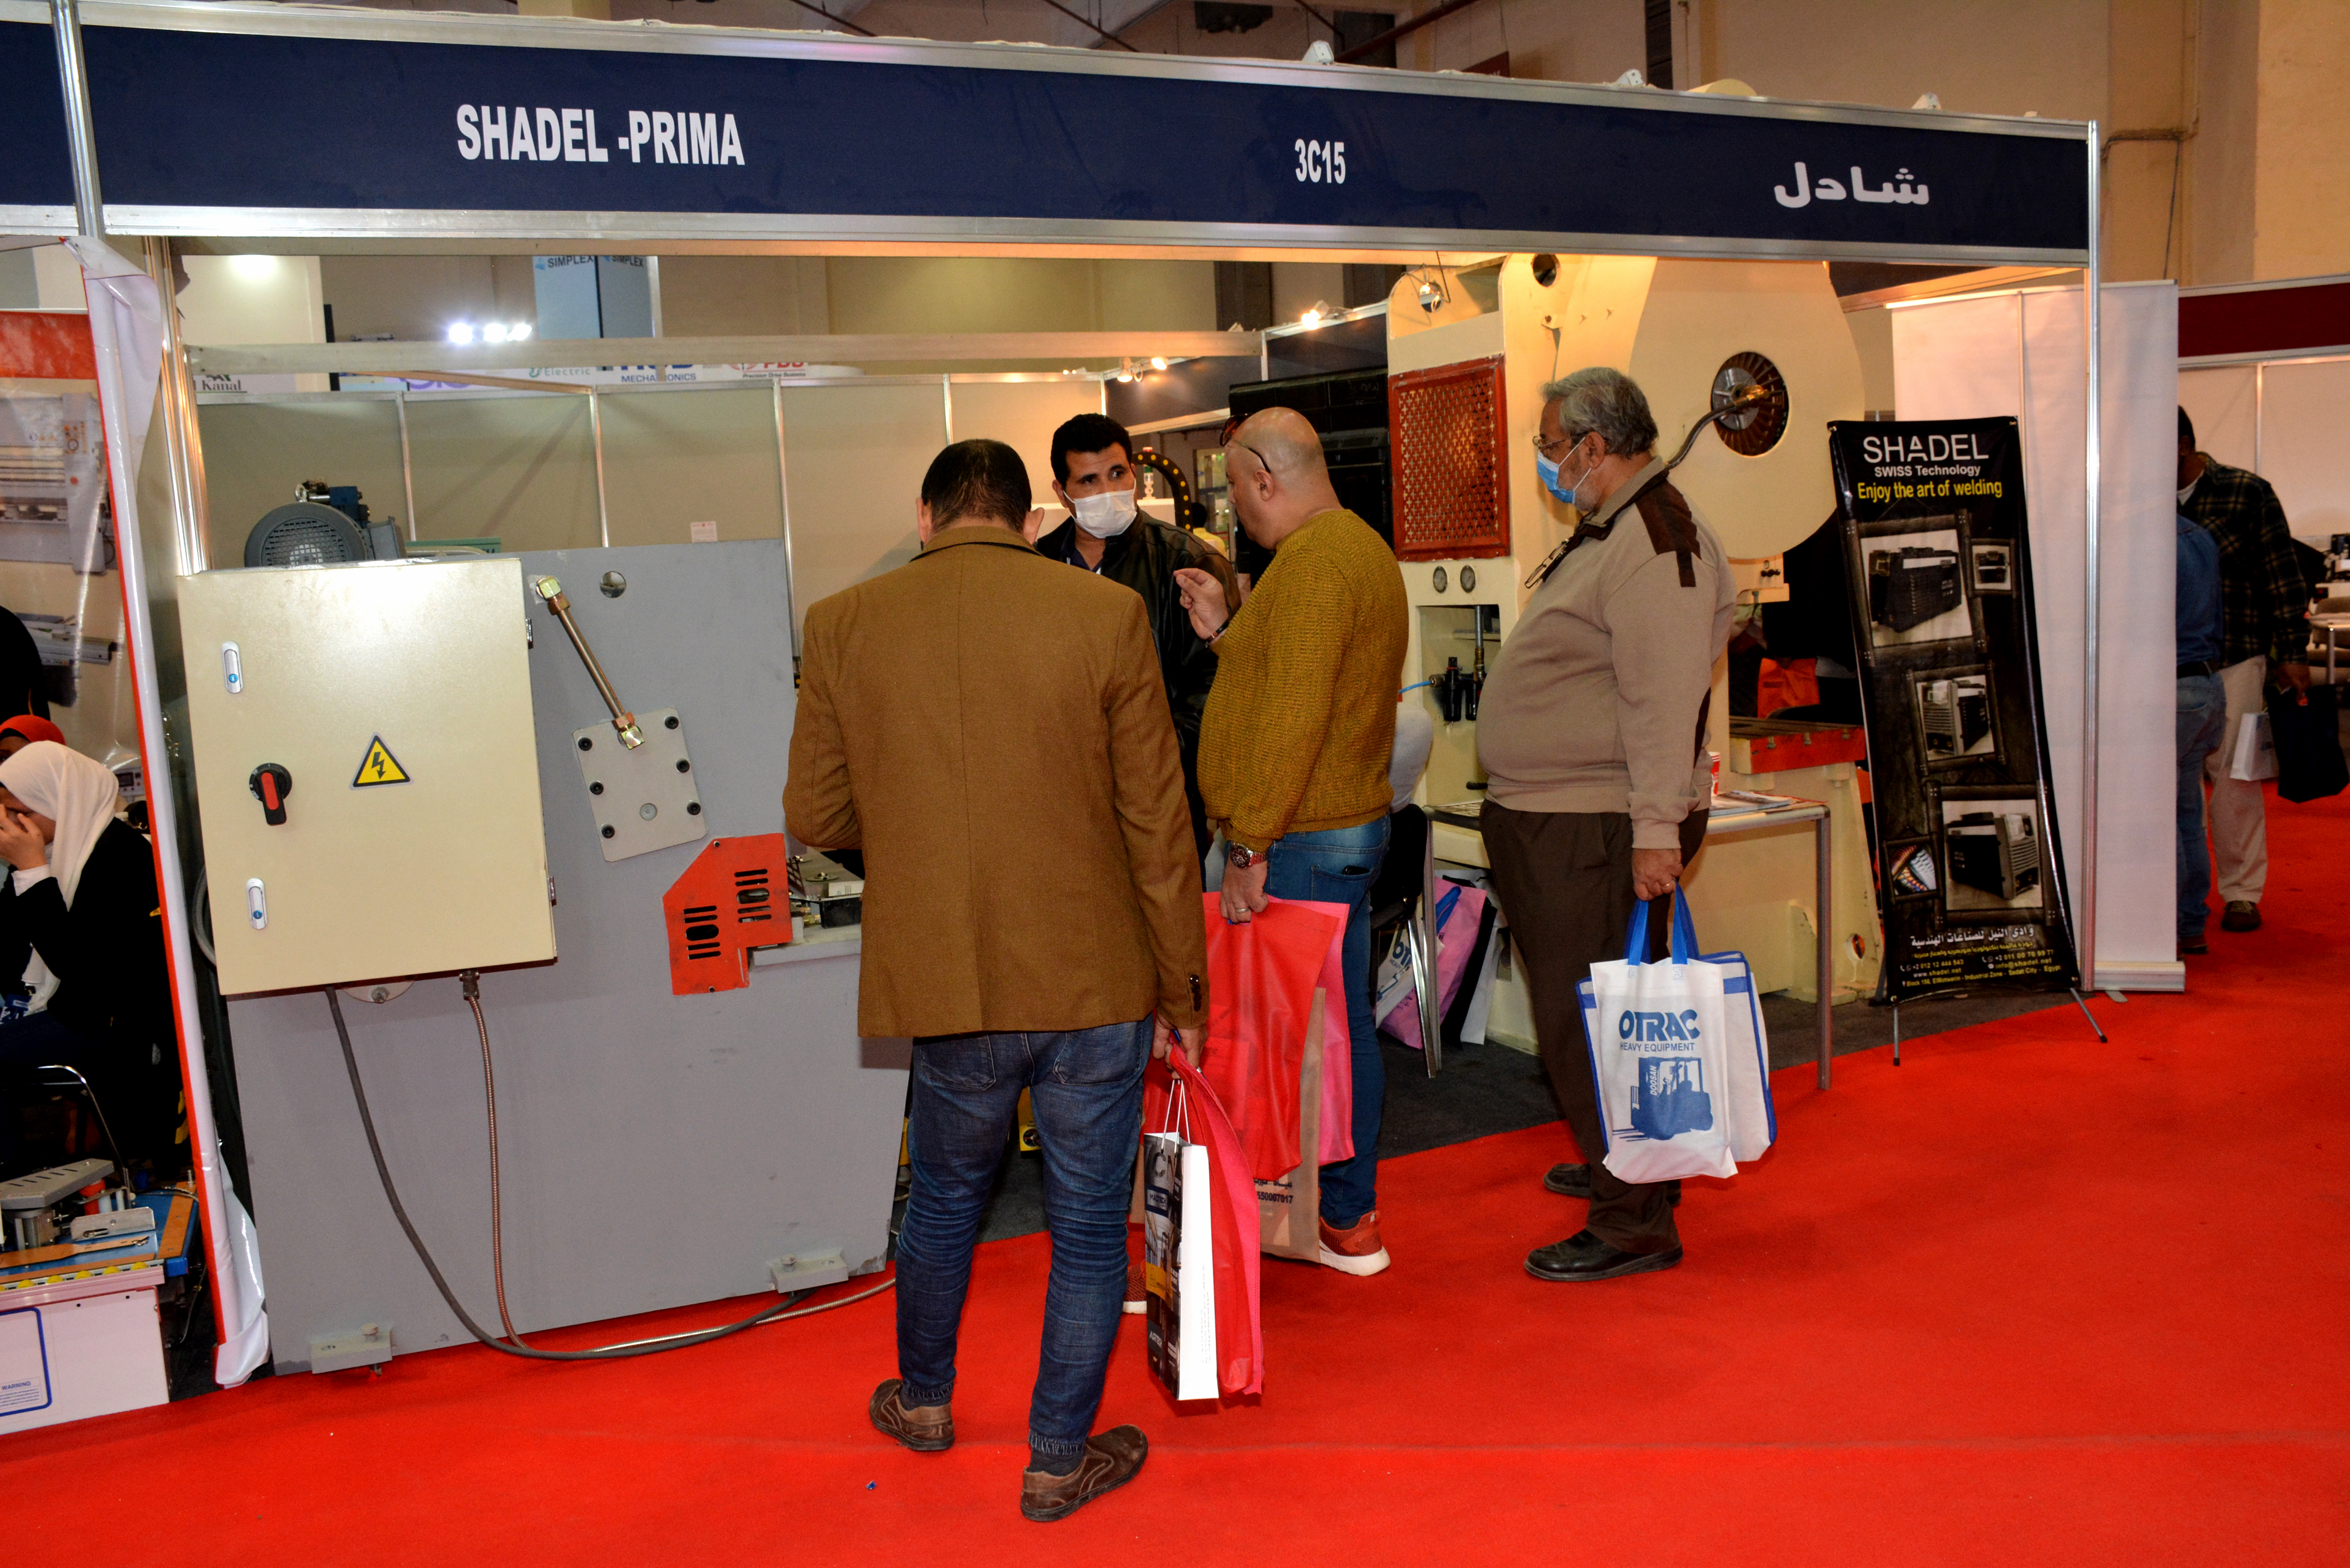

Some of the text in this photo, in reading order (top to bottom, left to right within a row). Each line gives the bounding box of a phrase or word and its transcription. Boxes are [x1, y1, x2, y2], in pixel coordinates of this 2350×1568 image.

[456, 103, 609, 163] SHADEL
[1294, 138, 1346, 185] 3C15
[1774, 161, 1930, 209] شادل
[548, 255, 595, 268] SIMPLEX
[621, 373, 696, 383] MECHAONICS
[202, 379, 241, 391] Kanal
[1863, 434, 1989, 464] SHADEL
[1874, 464, 1981, 478] SWISS Technology
[1858, 478, 2002, 503] Enjoy the art of welding
[1946, 930, 1984, 943] للصناعات
[1988, 928, 2008, 941] النيل
[1618, 1009, 1701, 1042] OTRAC
[1620, 1042, 1695, 1052] HEAVY EQUIPMENT
[2, 1380, 31, 1390] WARNING
